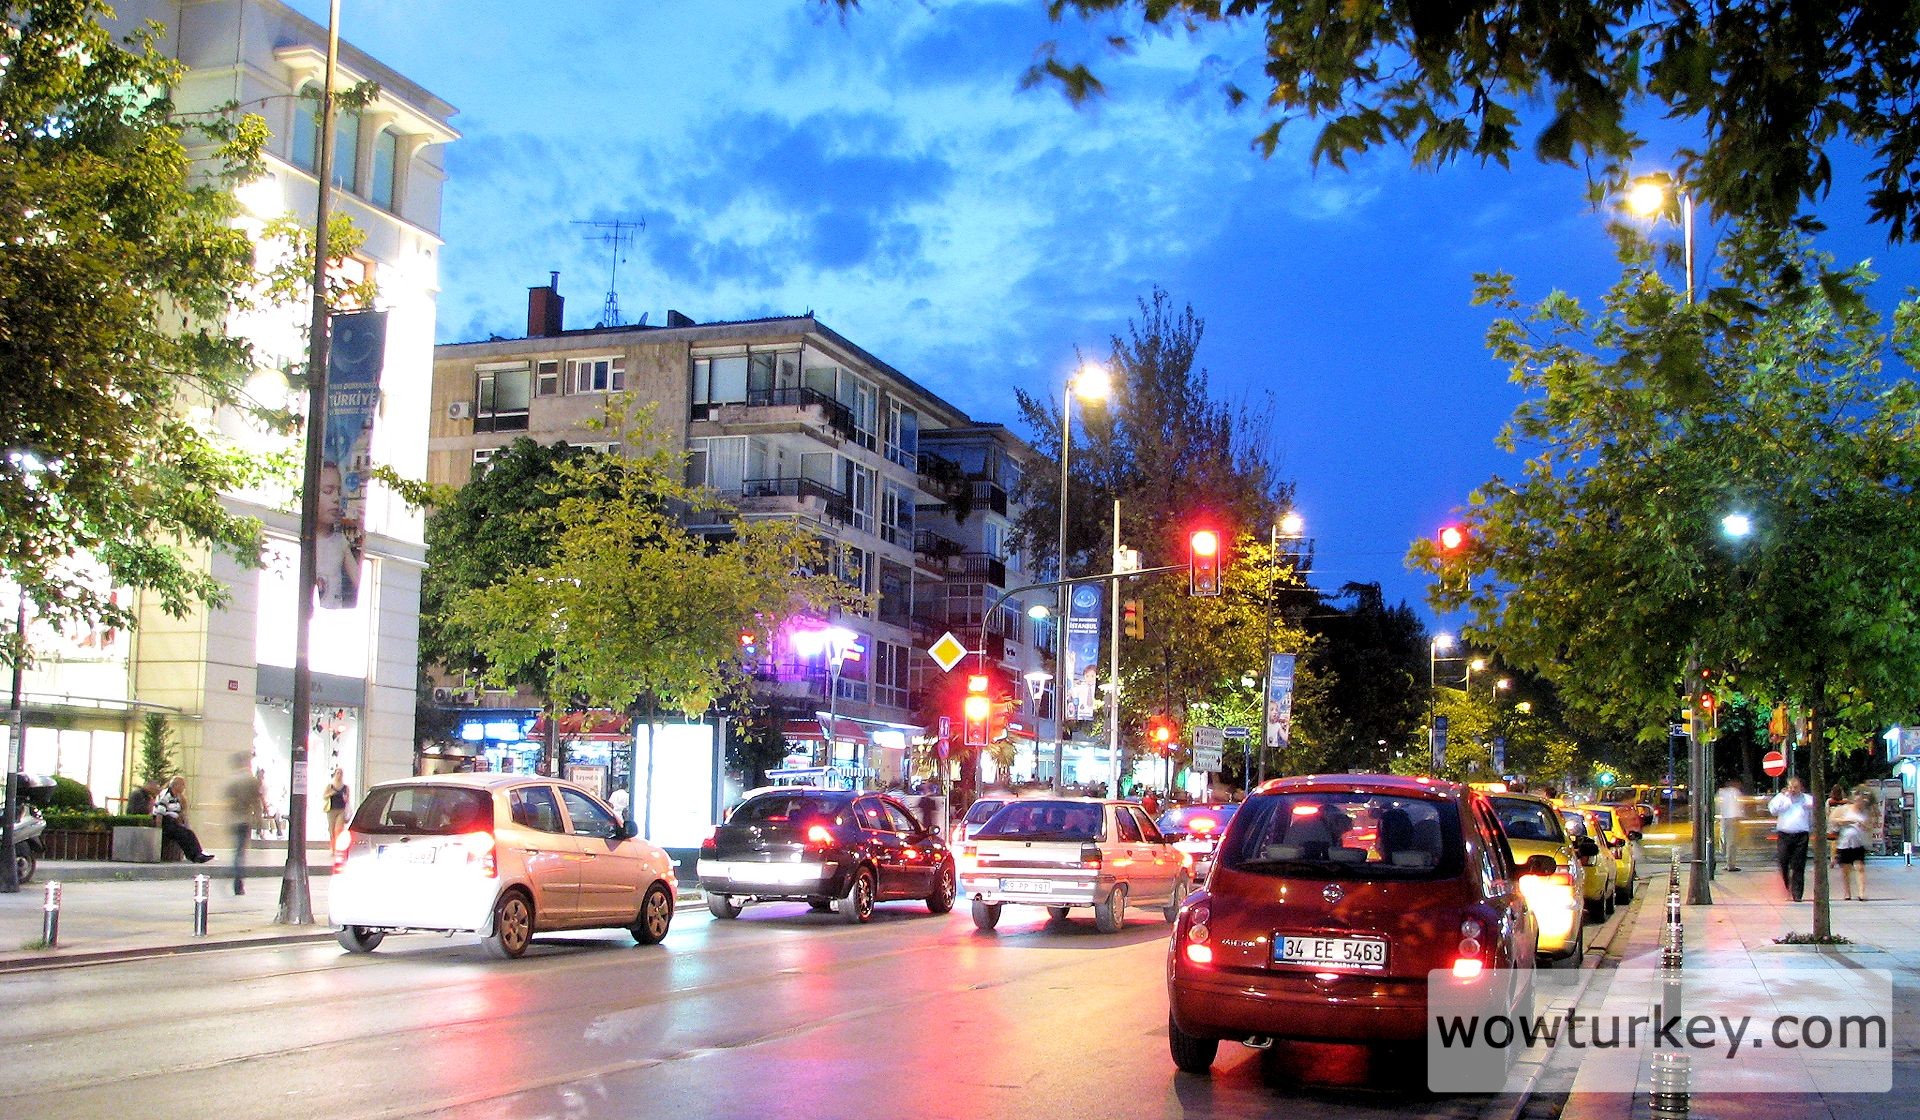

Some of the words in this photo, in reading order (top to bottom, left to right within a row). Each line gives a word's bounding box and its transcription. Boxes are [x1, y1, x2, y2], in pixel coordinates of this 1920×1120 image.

[1285, 940, 1304, 957] 34
[1315, 941, 1335, 958] EE
[1343, 942, 1383, 961] 5463
